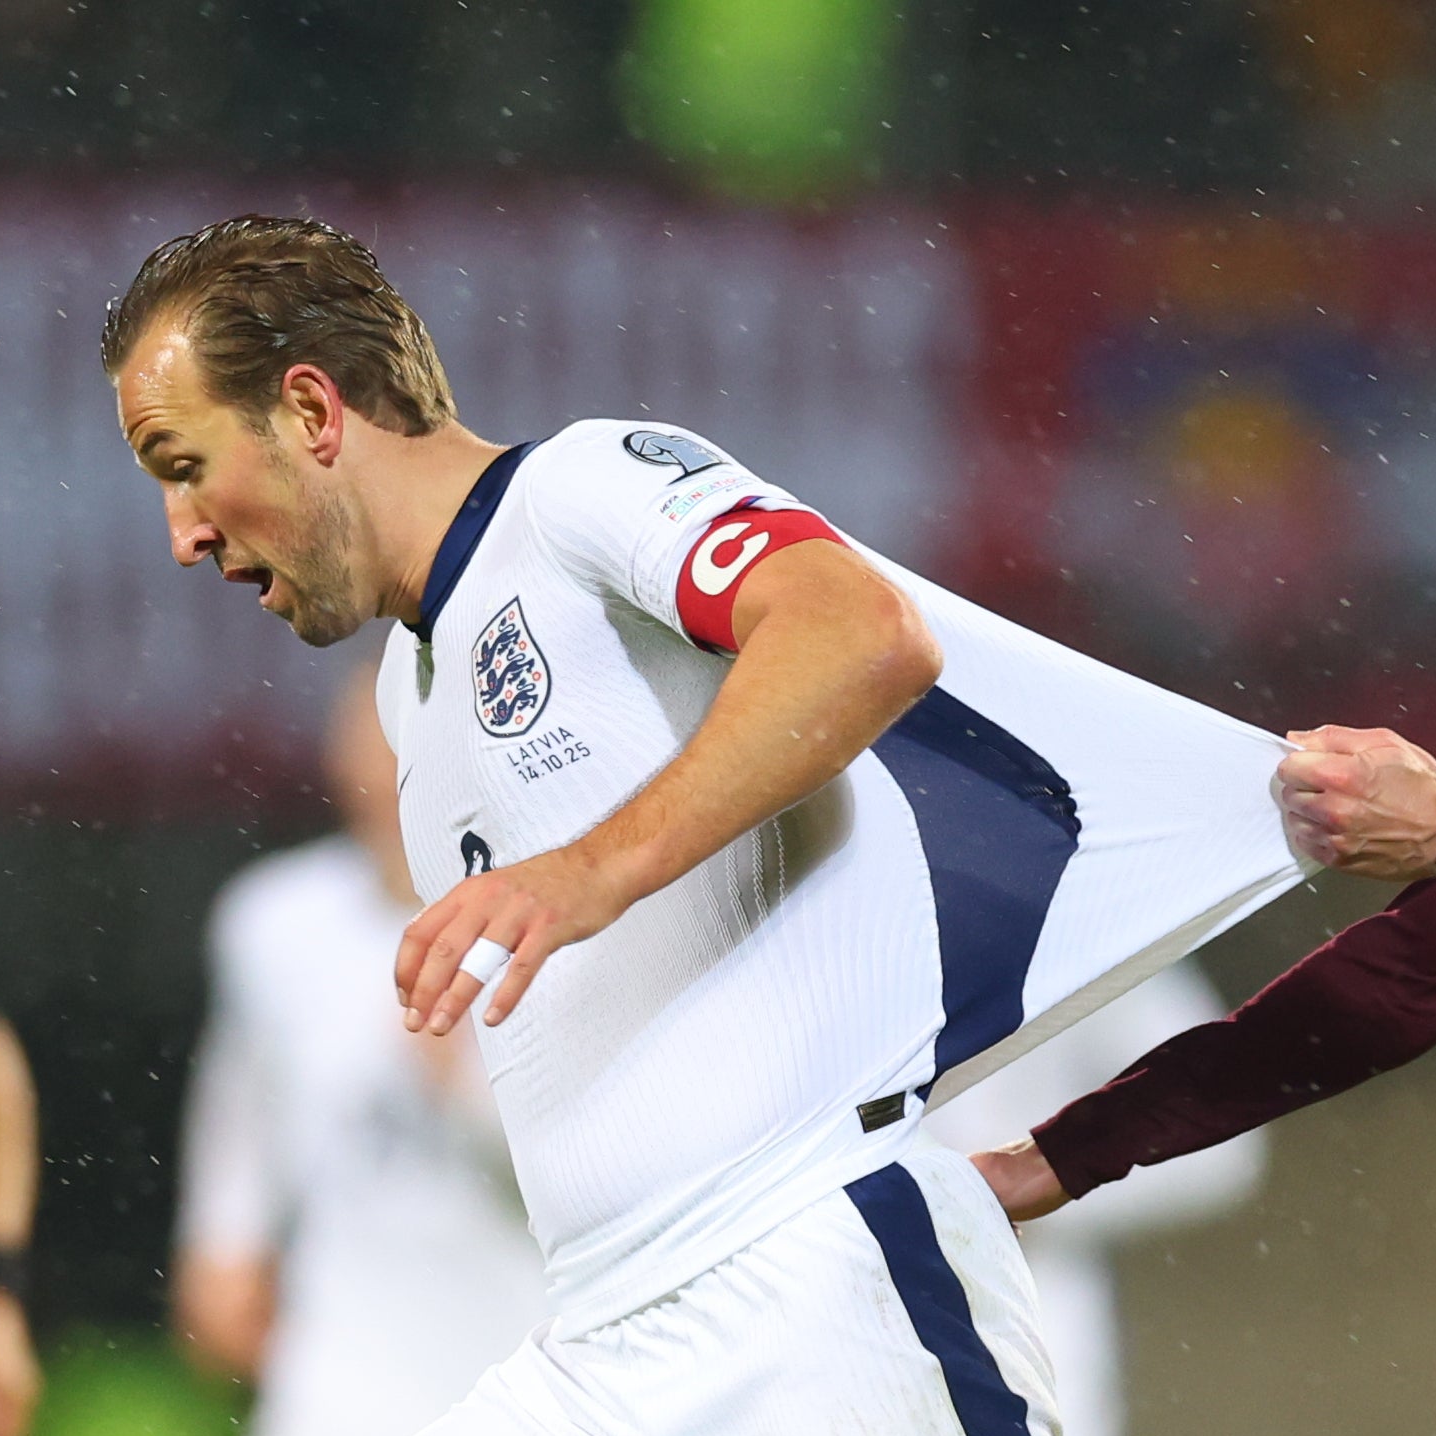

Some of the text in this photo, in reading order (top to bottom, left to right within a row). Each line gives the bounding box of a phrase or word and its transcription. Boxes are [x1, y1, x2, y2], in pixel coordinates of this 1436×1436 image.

[660, 495, 679, 513] UEFA
[691, 522, 769, 596] C
[507, 727, 574, 767] LATVIA
[518, 742, 591, 783] 14.10.25
